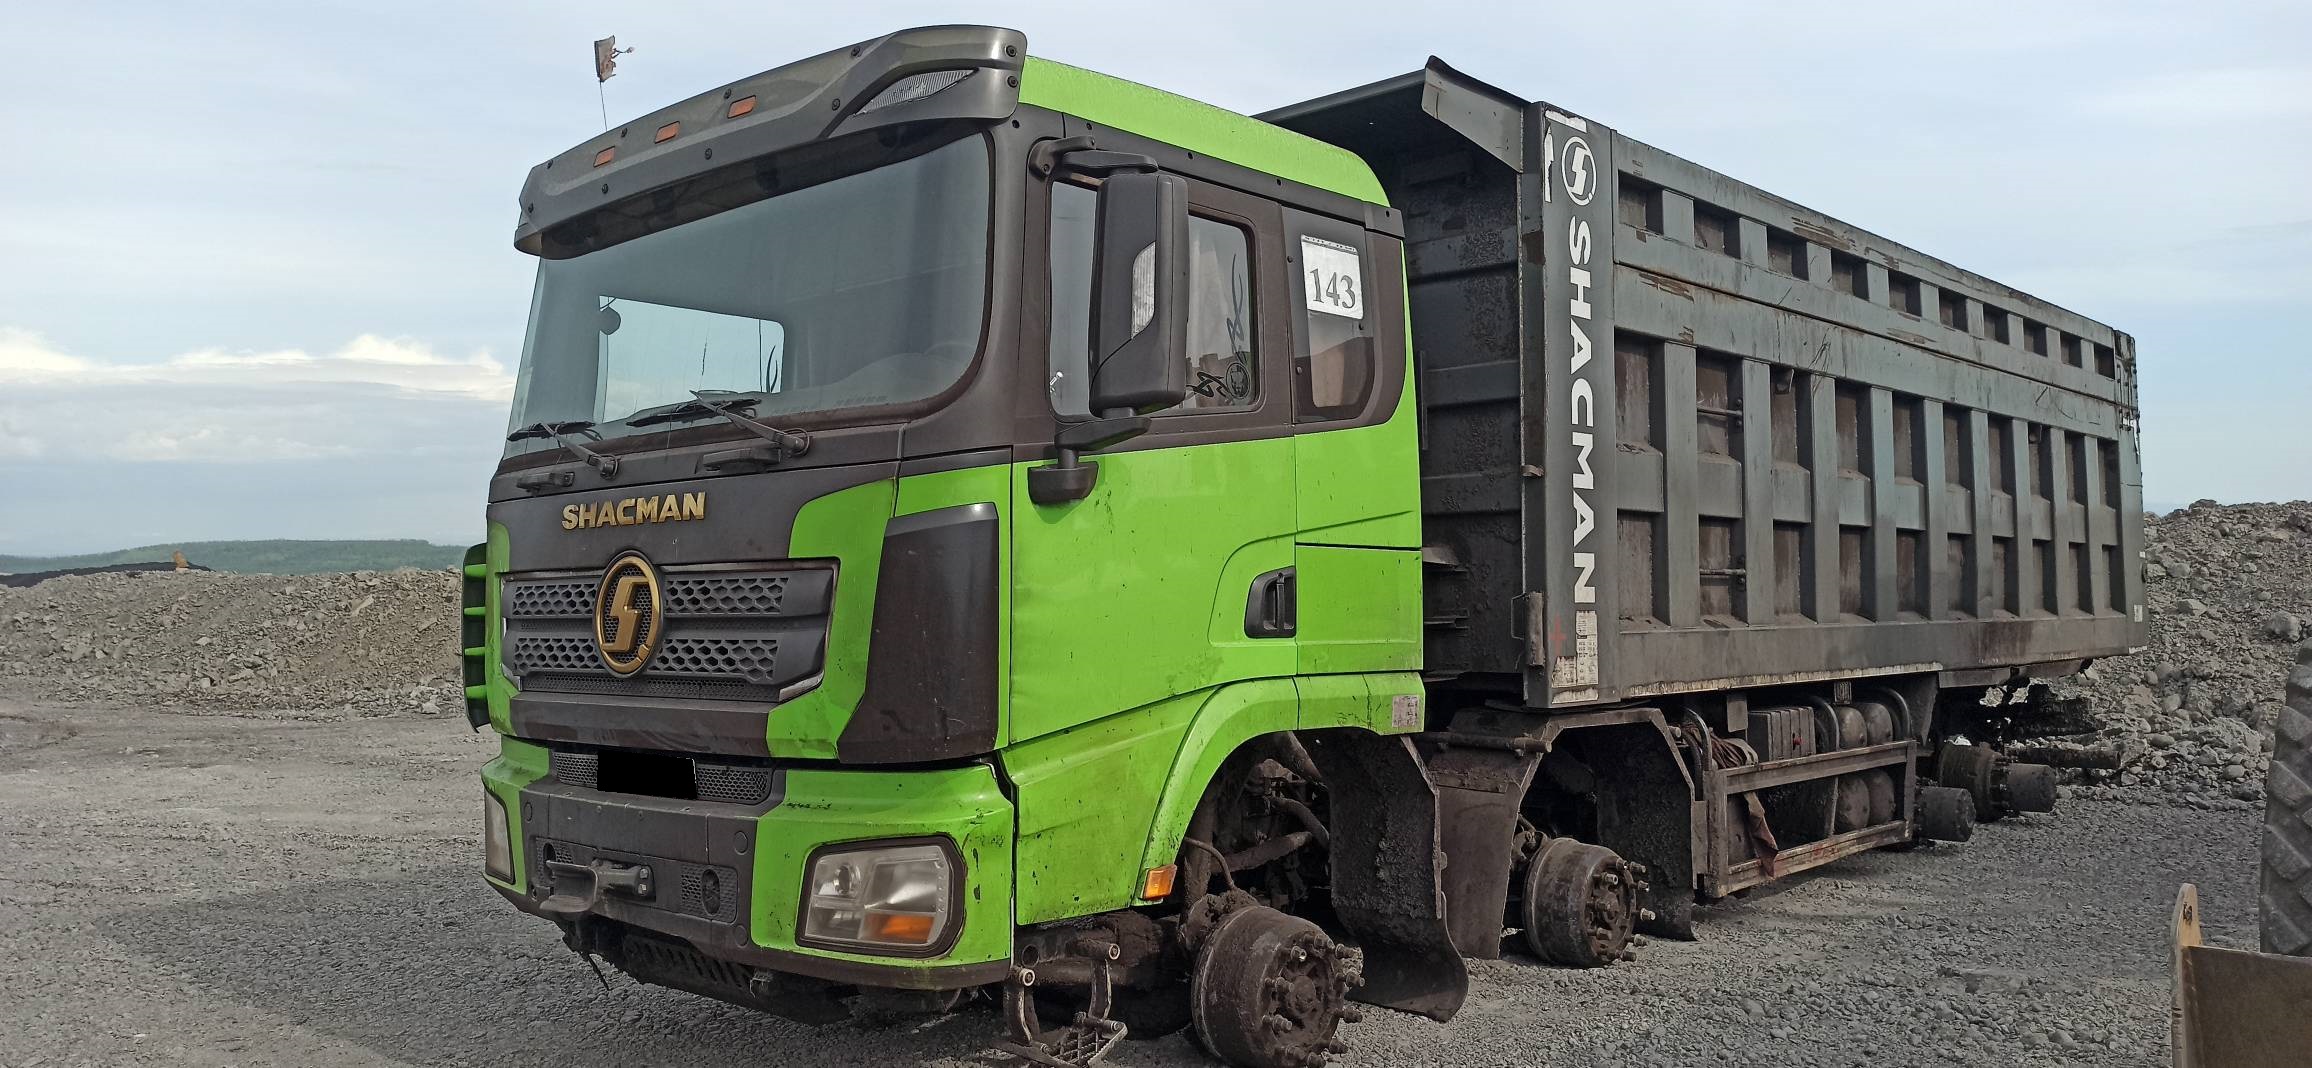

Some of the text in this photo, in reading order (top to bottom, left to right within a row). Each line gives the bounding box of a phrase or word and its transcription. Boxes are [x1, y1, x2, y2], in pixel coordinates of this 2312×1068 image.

[1309, 268, 1356, 309] 143
[1568, 215, 1596, 604] SHACMAN
[561, 491, 706, 530] SHACMAN
